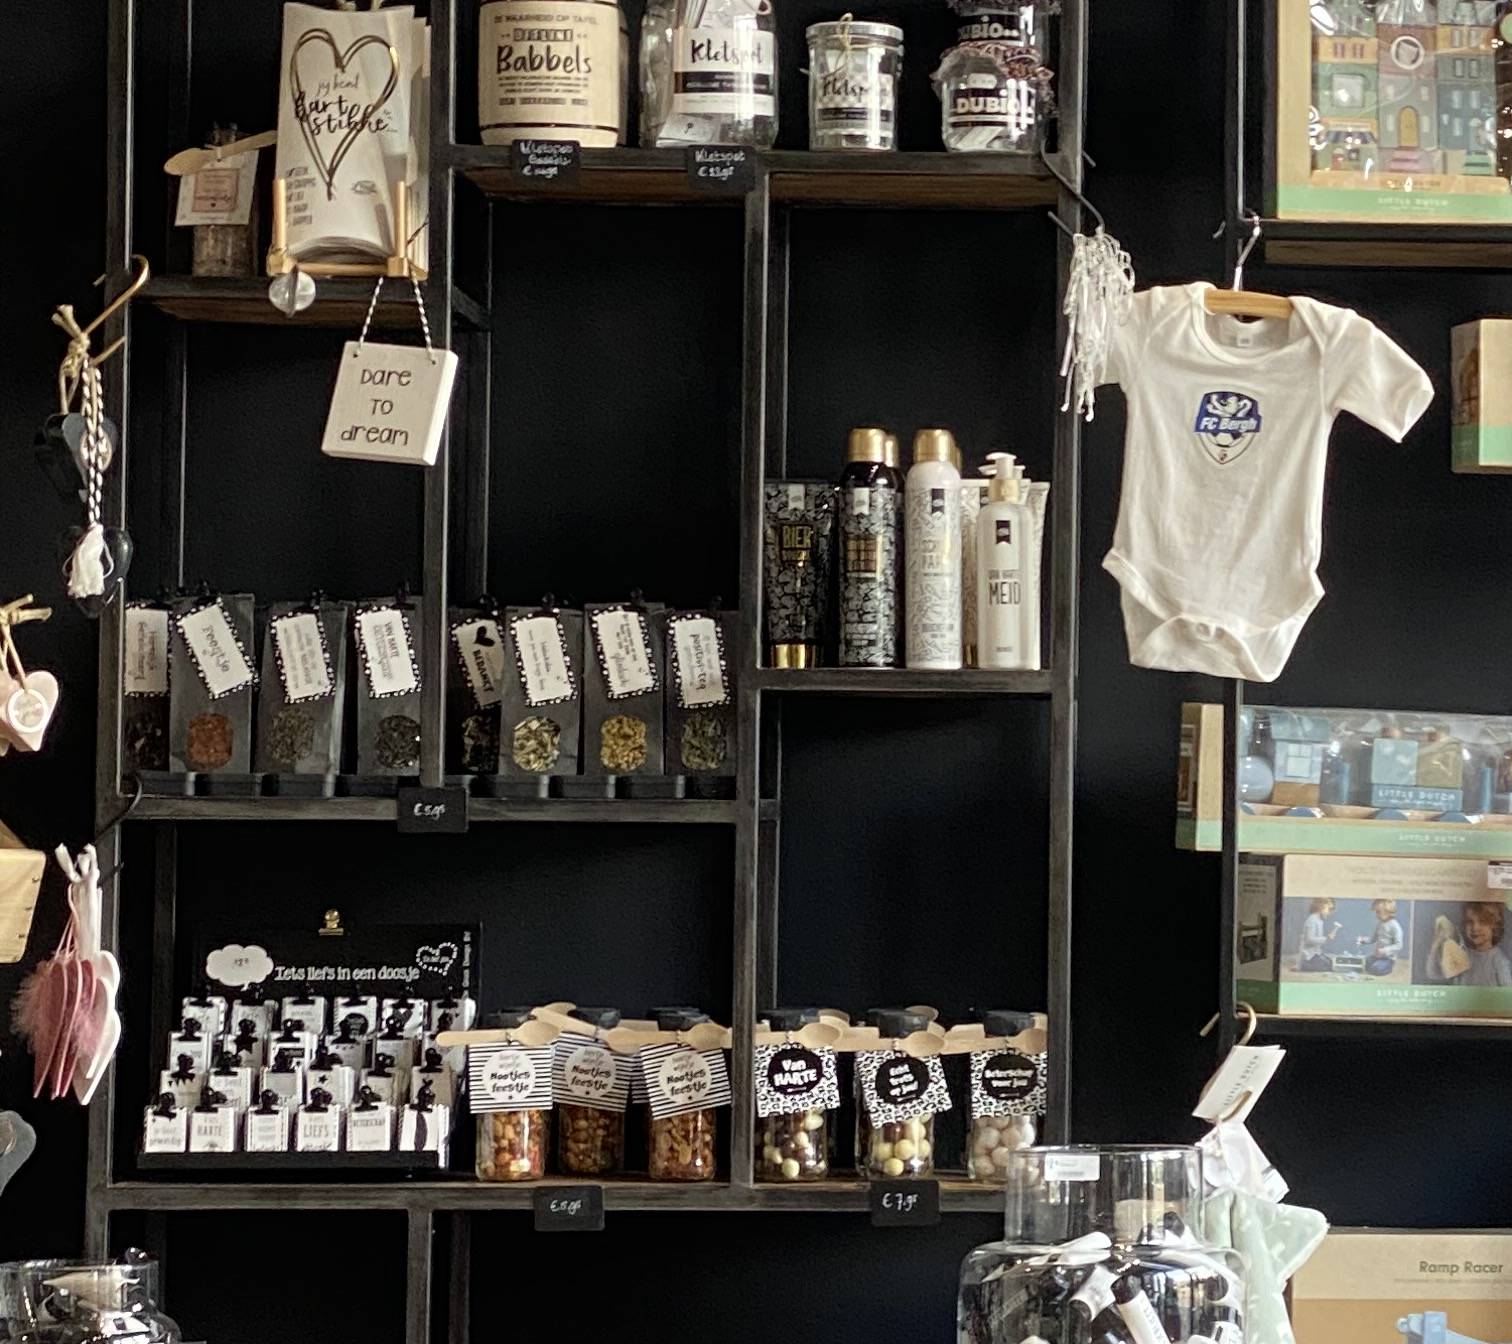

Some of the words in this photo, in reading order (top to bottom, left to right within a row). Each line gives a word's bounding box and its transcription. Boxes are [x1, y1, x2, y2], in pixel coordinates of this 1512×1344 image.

[496, 44, 592, 74] Babbels
[360, 367, 413, 388] Dare
[369, 398, 394, 416] TO
[1199, 417, 1219, 431] FC
[340, 423, 409, 447] dream
[988, 582, 1022, 605] MEID
[337, 966, 351, 981] in
[352, 967, 377, 981] een
[378, 965, 421, 983] doosje
[773, 1068, 818, 1087] HARTE
[1418, 1260, 1460, 1276] Ramp
[1463, 1260, 1505, 1273] Racer
